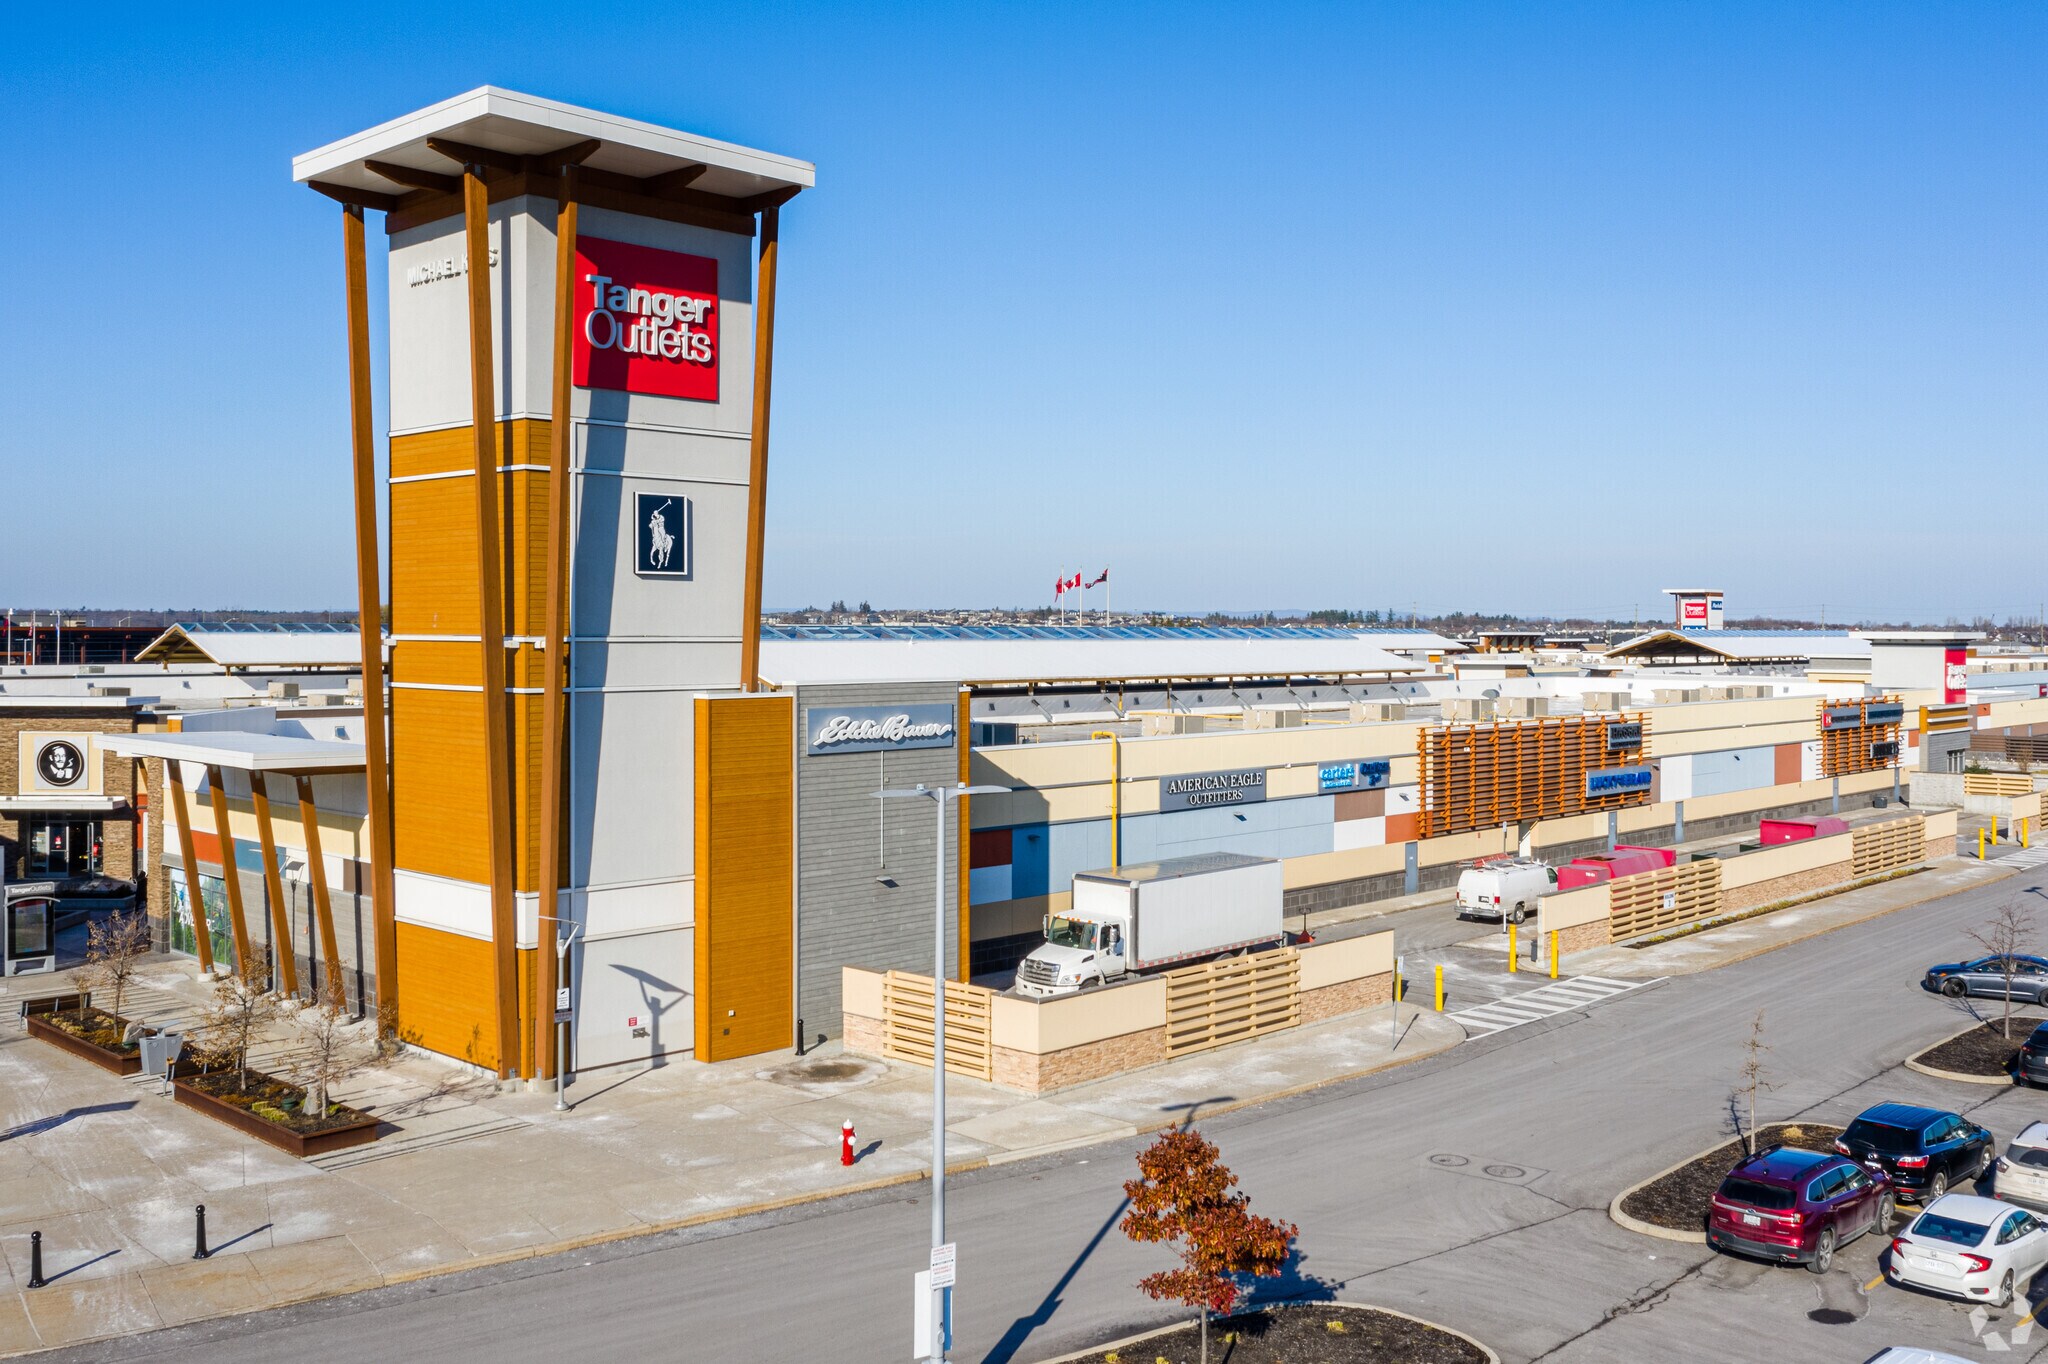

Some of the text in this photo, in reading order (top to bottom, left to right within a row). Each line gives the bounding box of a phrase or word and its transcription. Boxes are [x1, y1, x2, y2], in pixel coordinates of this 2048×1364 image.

[407, 248, 498, 286] MICHAEL KS
[585, 274, 711, 327] Tanger
[585, 309, 712, 362] Outlets
[813, 714, 952, 746] Eddie Bauer
[1168, 772, 1263, 794] AMERICAN EAGLE
[1189, 789, 1243, 805] OUTFITTERS
